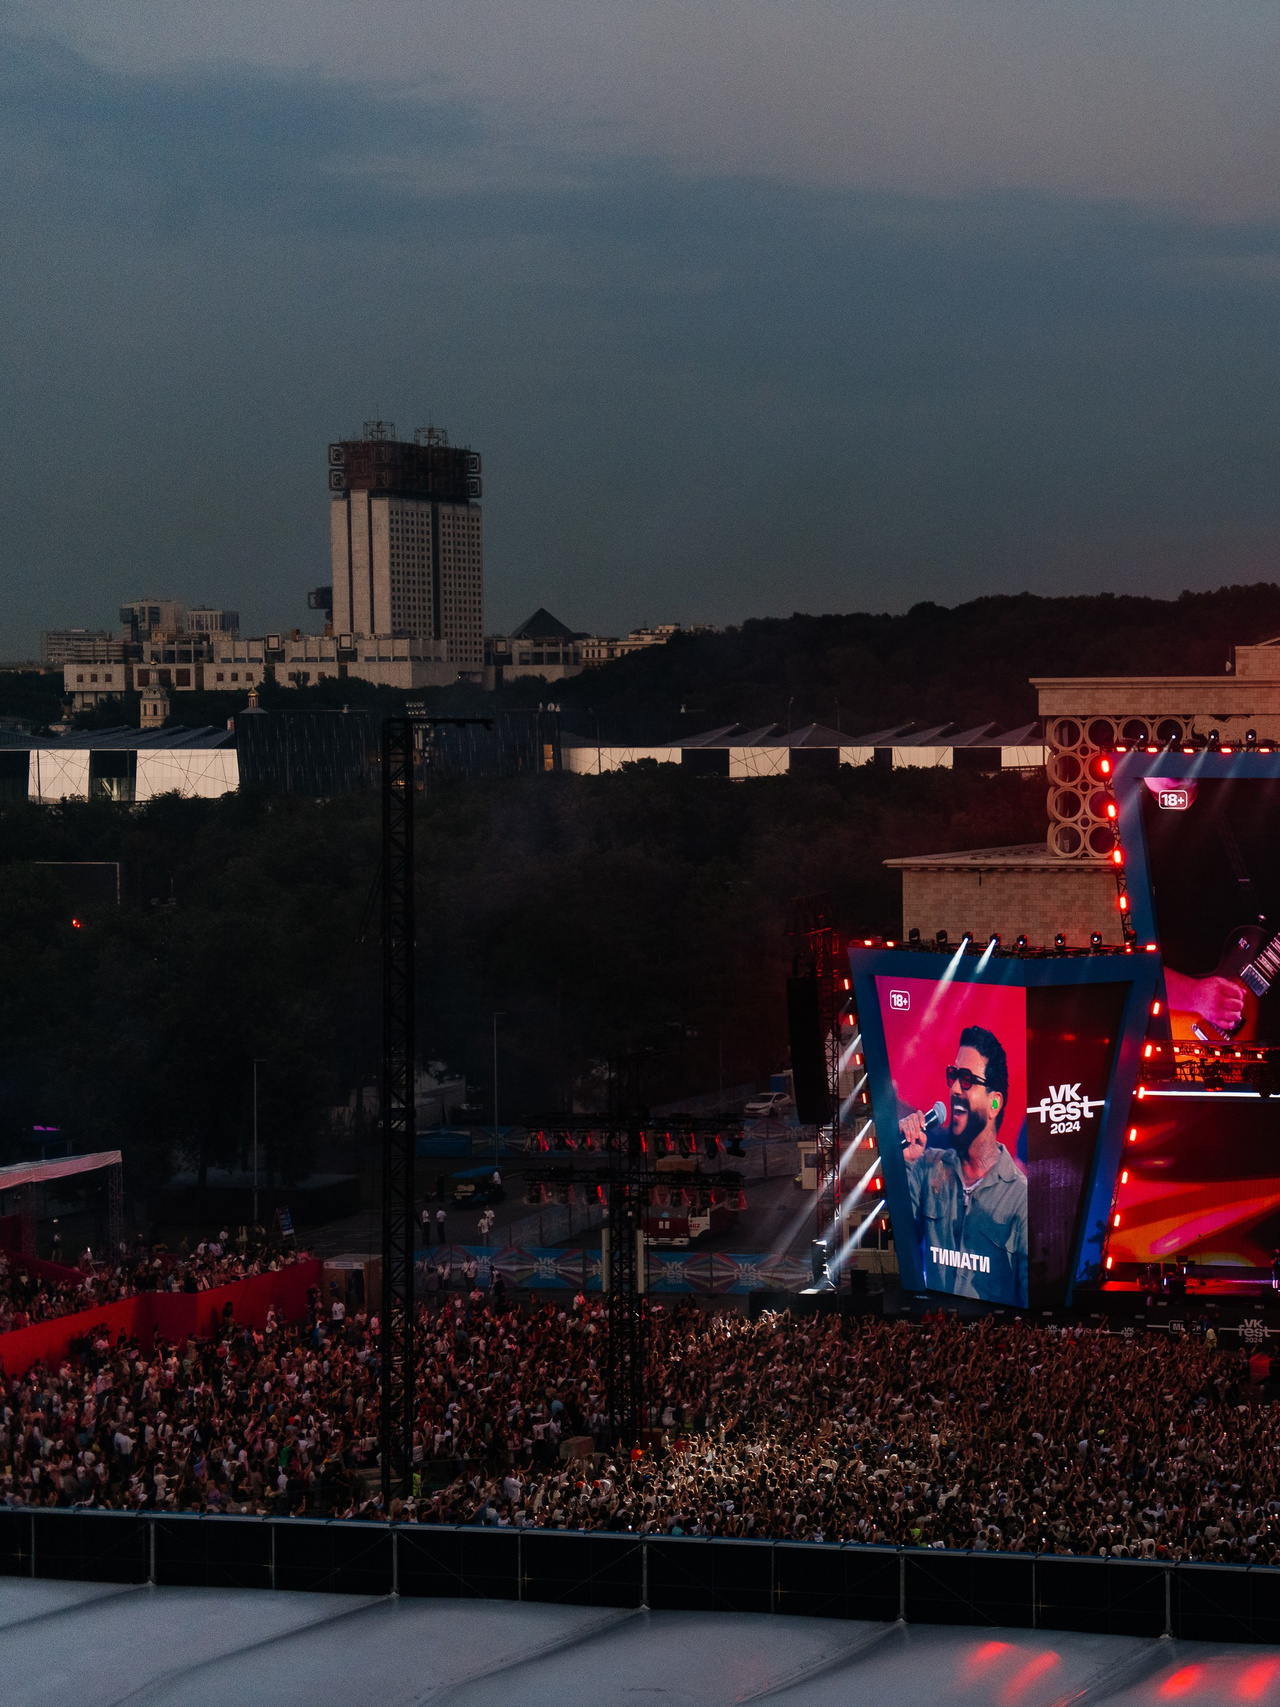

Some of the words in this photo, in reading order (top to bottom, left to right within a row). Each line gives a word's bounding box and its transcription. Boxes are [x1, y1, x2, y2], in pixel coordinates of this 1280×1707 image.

[1160, 793, 1186, 807] 18+
[891, 993, 909, 1008] 18+
[1048, 1082, 1082, 1103] VK
[1039, 1095, 1094, 1123] fest
[1050, 1120, 1081, 1135] 2024
[930, 1246, 990, 1274] ТИМАТИ
[1238, 1324, 1271, 1338] fest
[1243, 1318, 1263, 1329] VK
